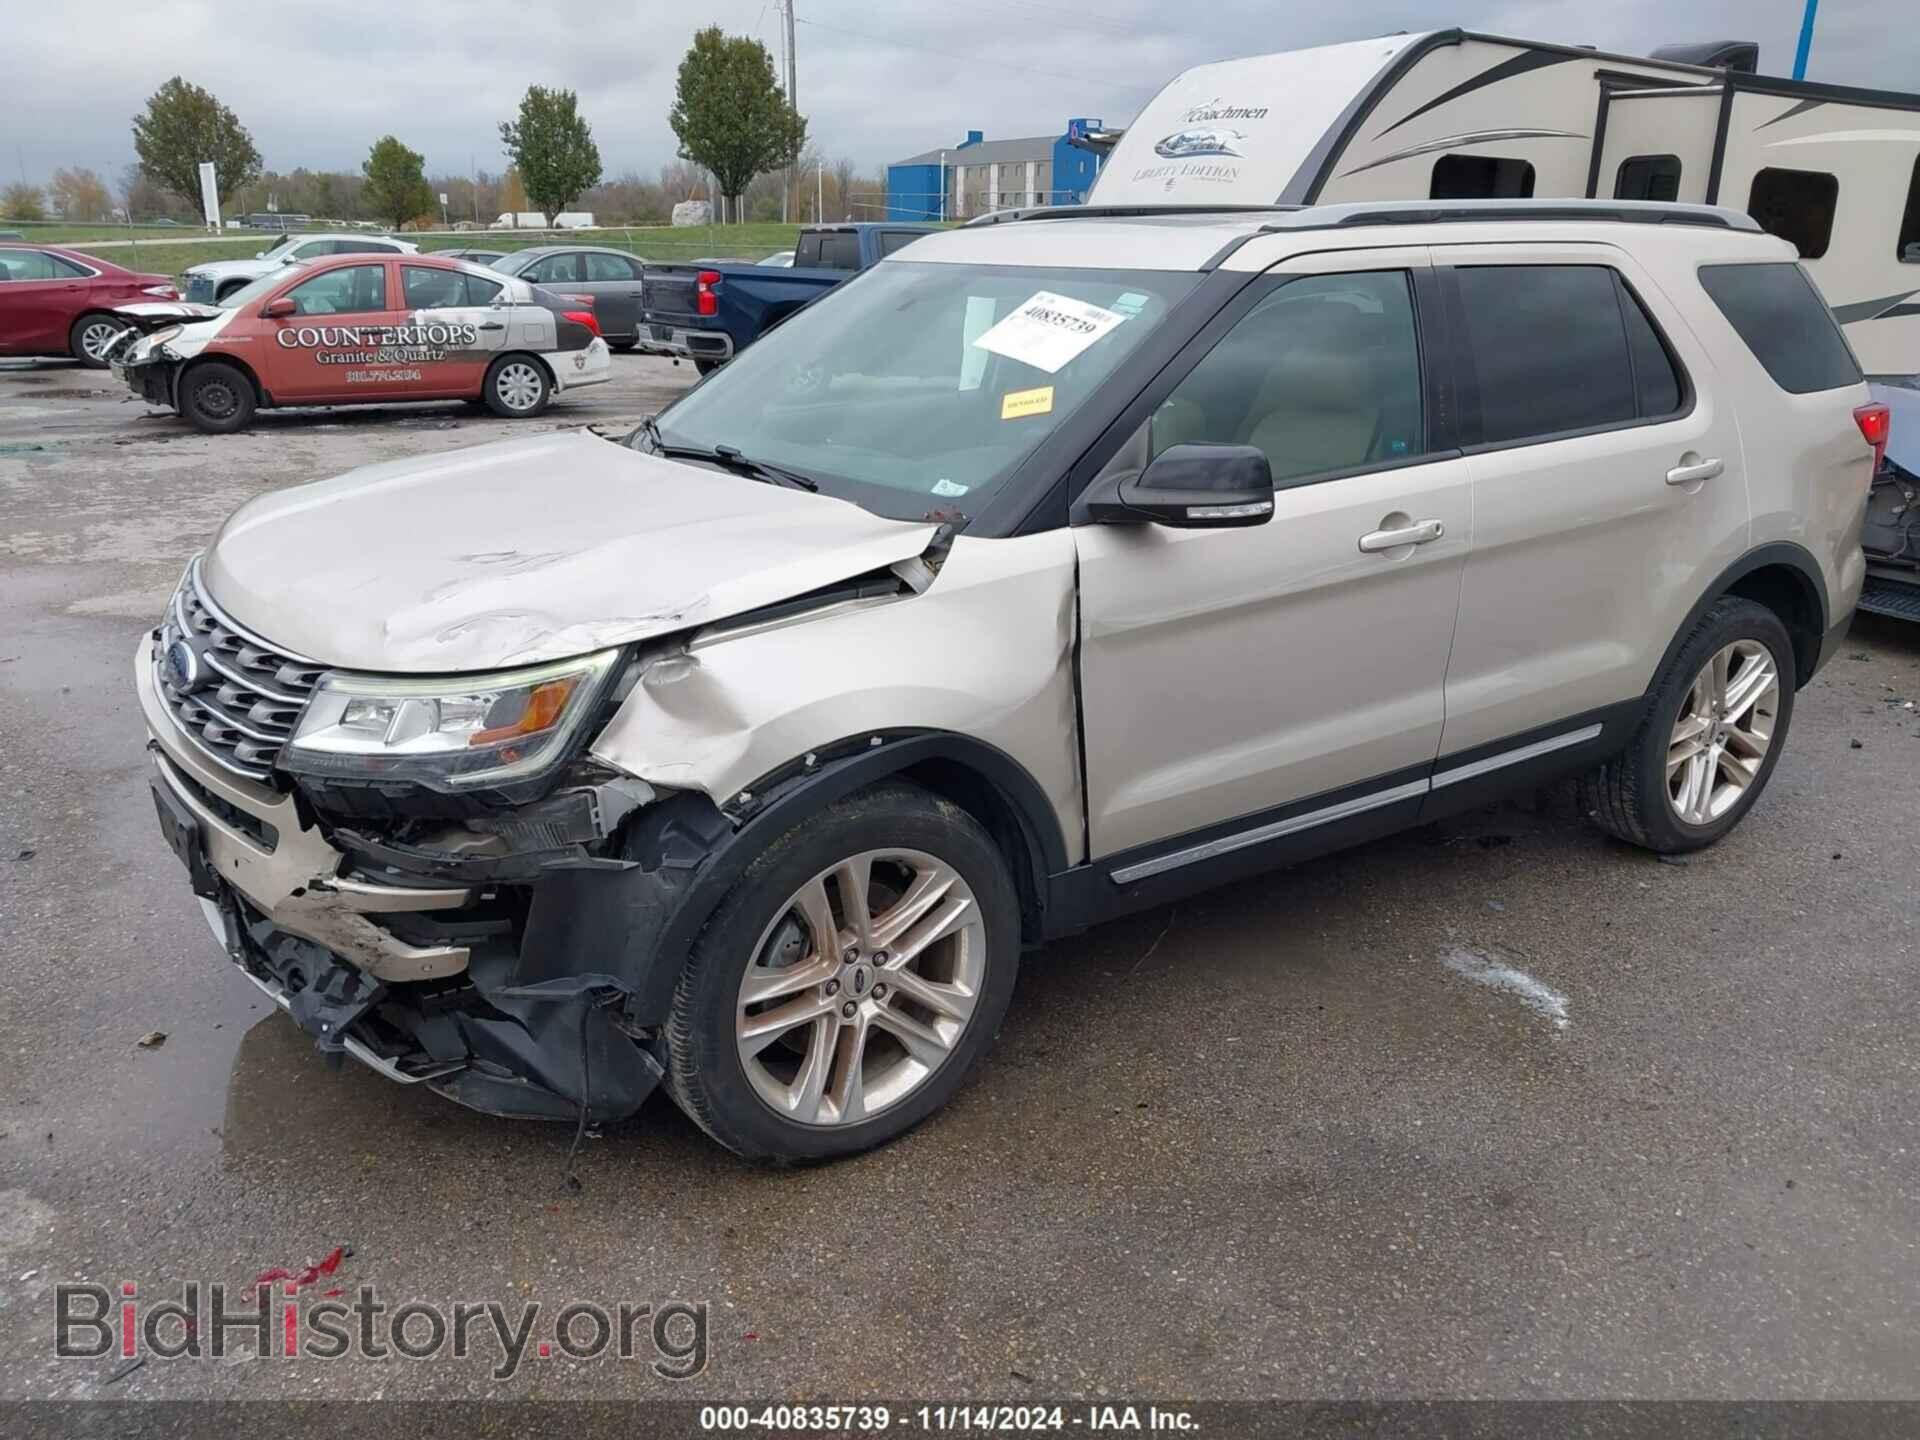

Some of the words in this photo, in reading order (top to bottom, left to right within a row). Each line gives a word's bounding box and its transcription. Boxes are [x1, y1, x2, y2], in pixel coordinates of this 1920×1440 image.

[1187, 106, 1269, 123] Coachmen
[1179, 163, 1240, 179] EDITION
[1024, 305, 1097, 334] 40835739
[276, 324, 477, 348] COUNTERTOPS
[316, 350, 374, 365] Granite
[377, 350, 391, 364] &
[394, 349, 446, 365] Quartz
